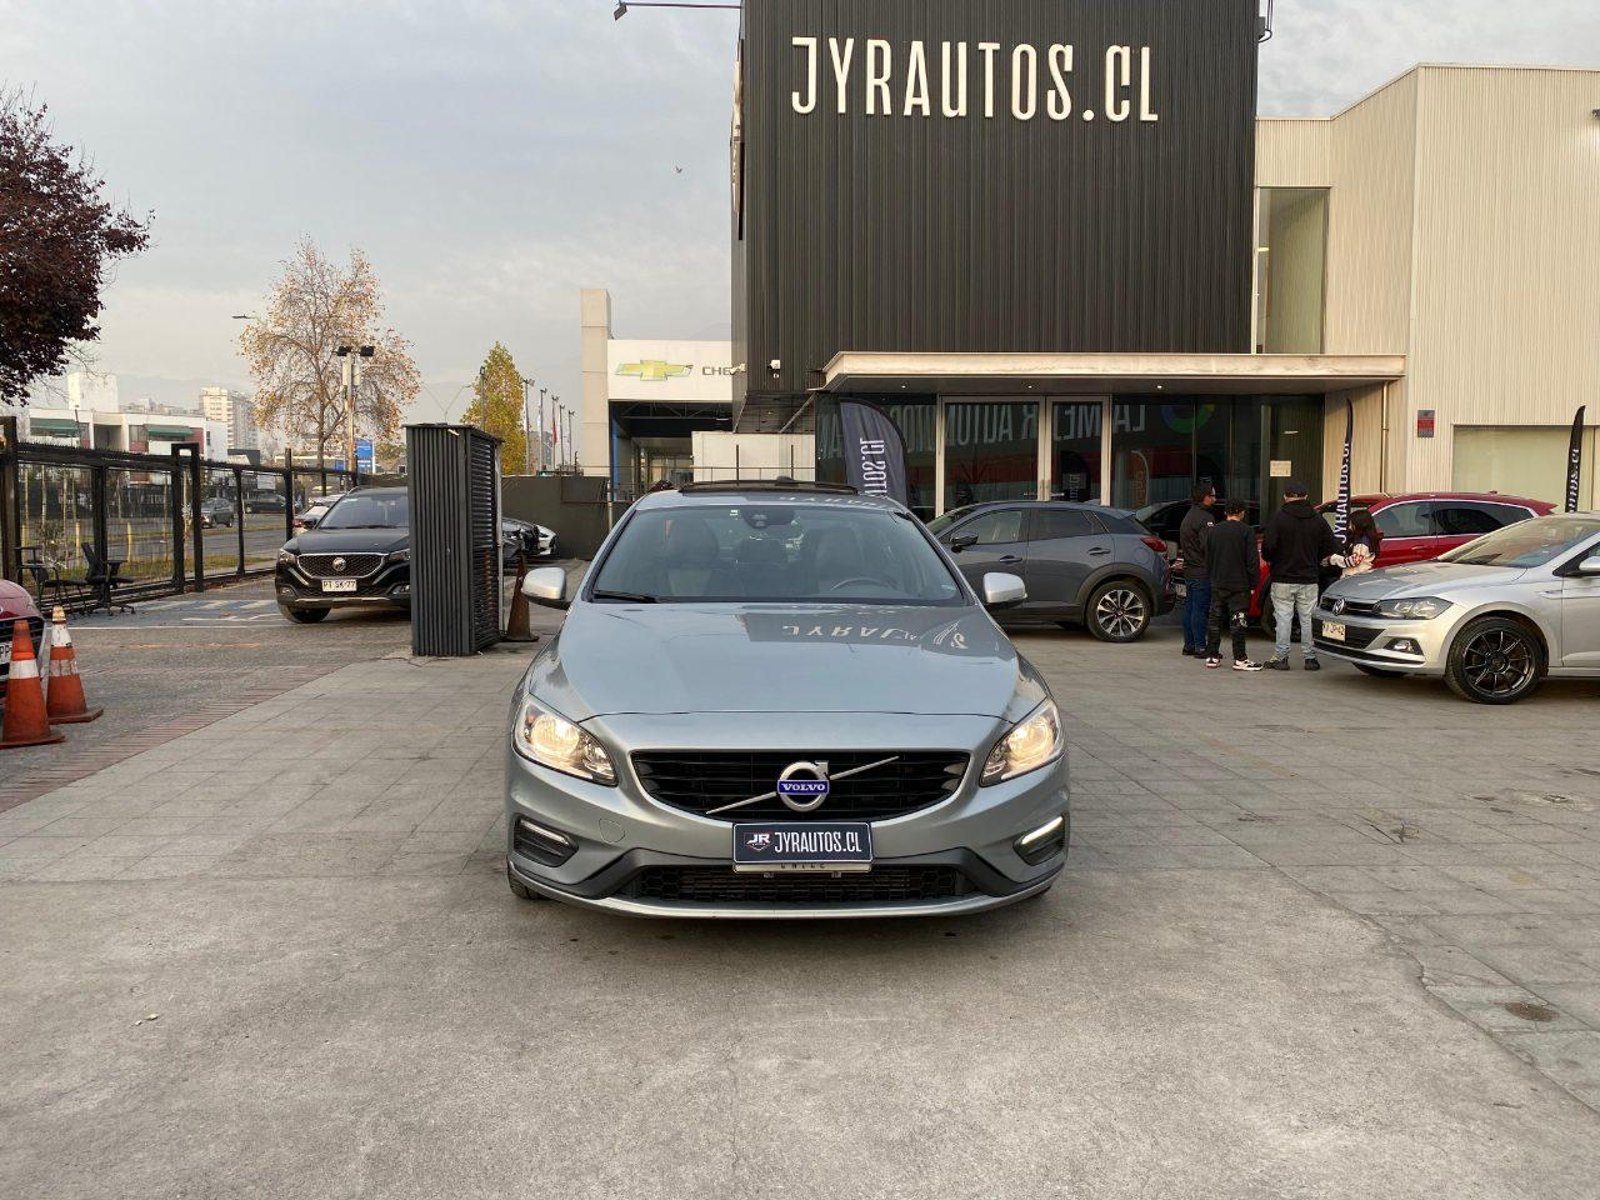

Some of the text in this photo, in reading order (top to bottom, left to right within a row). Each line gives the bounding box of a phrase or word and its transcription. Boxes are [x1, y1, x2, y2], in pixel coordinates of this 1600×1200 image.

[791, 36, 1159, 123] JYRAUTOS.CL
[781, 783, 826, 791] VOLVO
[774, 831, 863, 853] JYRAUTOS.CL
